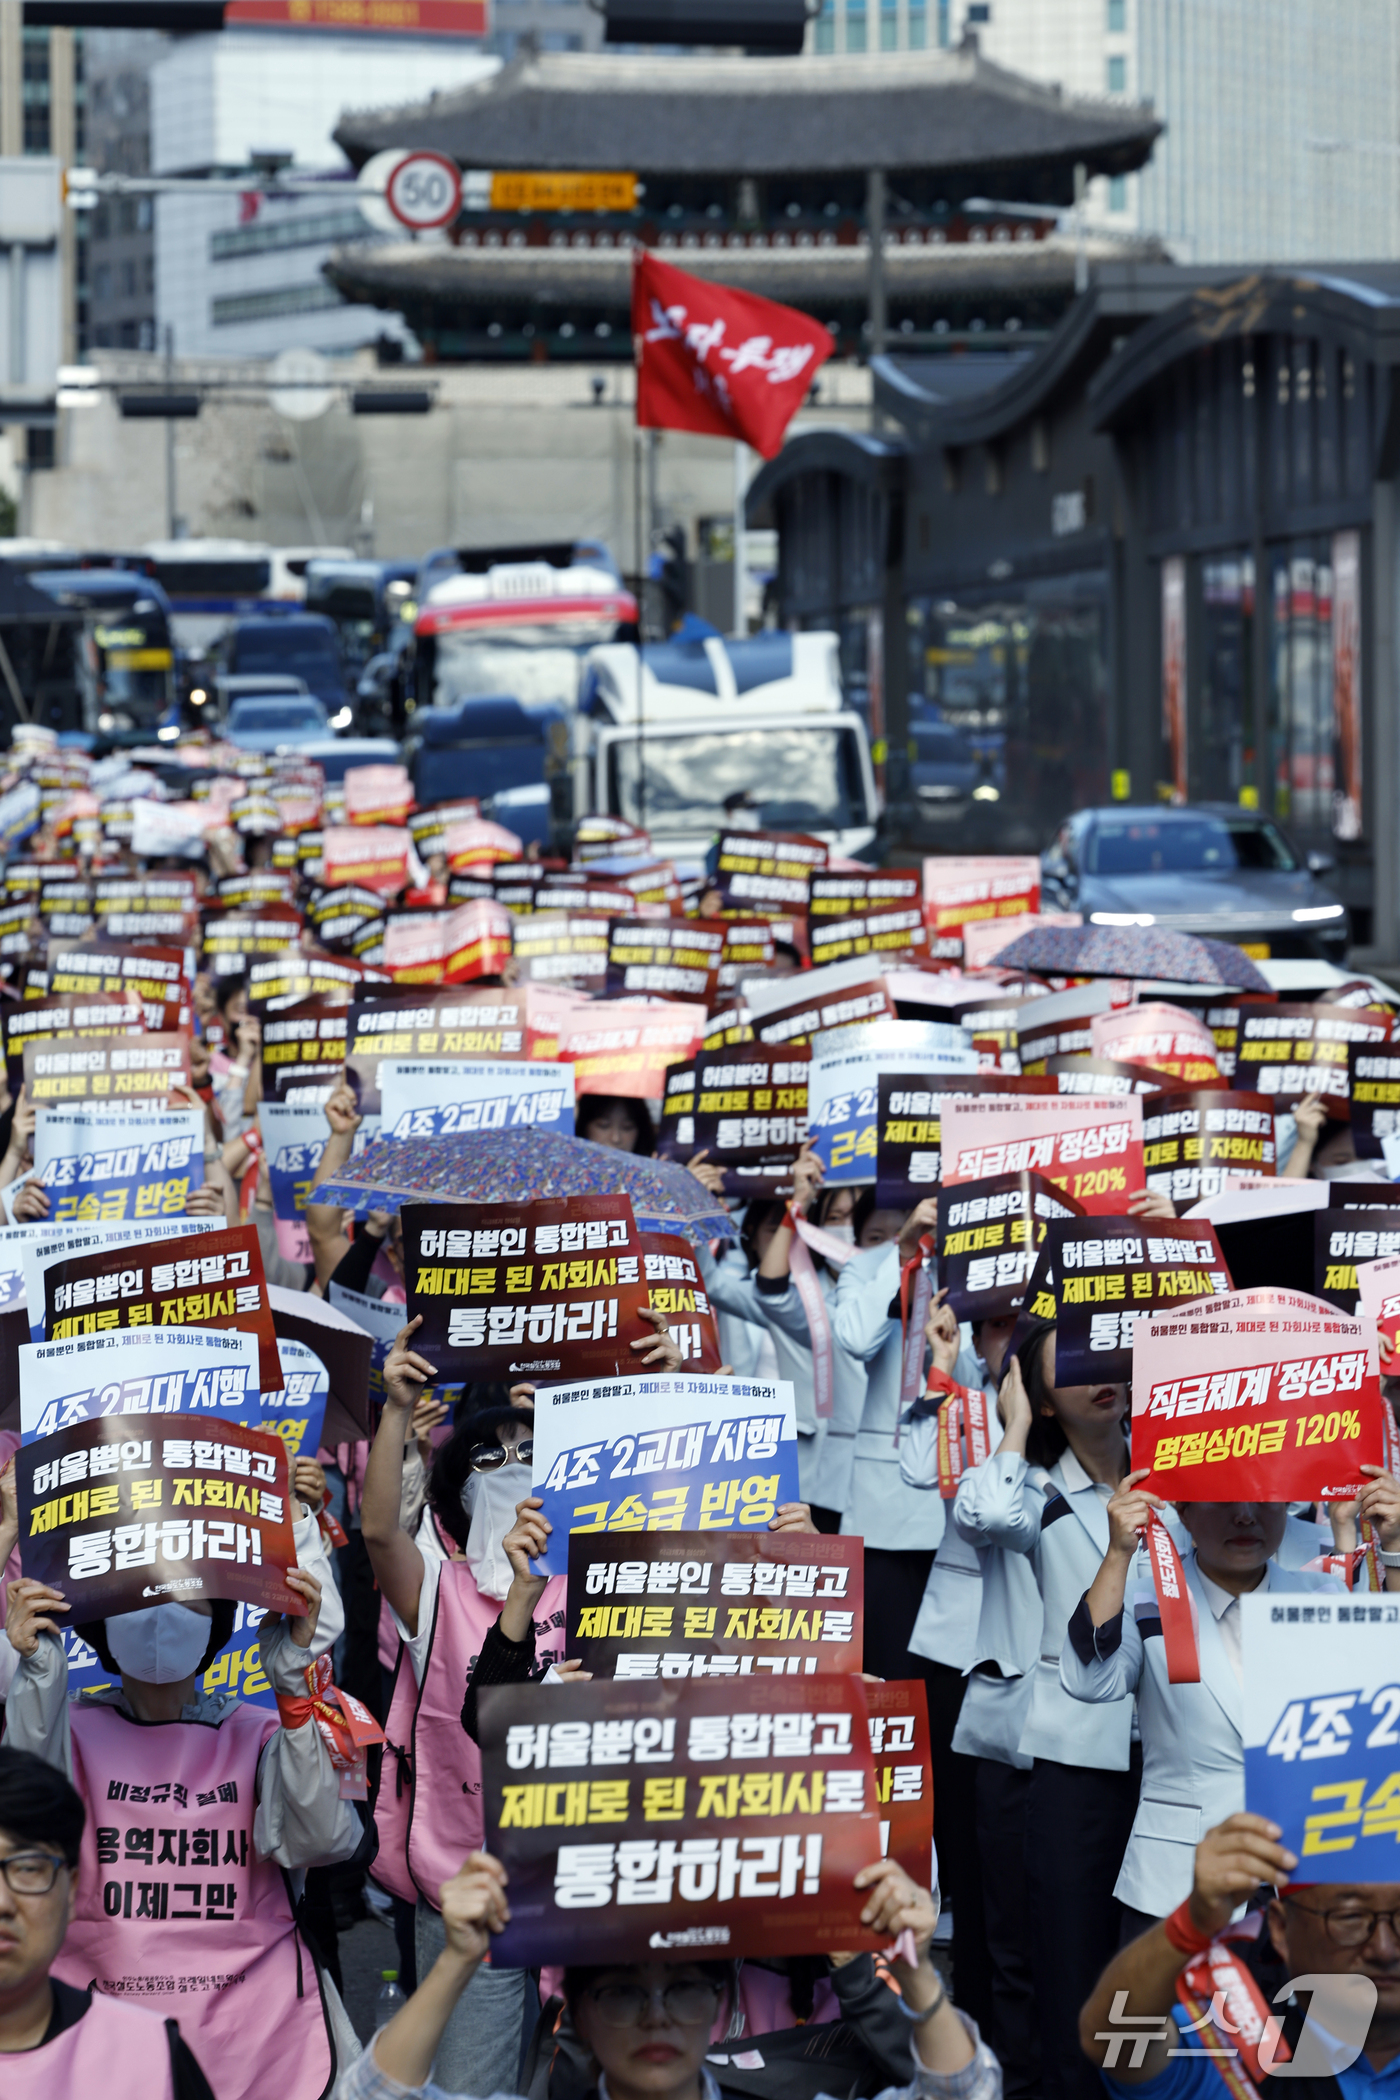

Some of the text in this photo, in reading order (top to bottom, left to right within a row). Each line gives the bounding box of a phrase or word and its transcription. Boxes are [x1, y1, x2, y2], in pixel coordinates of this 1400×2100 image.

[403, 172, 448, 210] 50
[392, 1090, 566, 1141] 4조 2교대 시행
[41, 1135, 195, 1188] 4조 2교대 시행
[956, 1137, 1056, 1181] 직급체계
[1058, 1121, 1131, 1164] 정상화
[54, 1176, 191, 1223] 근속급 반영
[1073, 1166, 1127, 1199] 120%
[418, 1219, 631, 1259] 허울뿐인 통합말고
[1061, 1236, 1217, 1269] 허울뿐인 통합말고
[53, 1269, 144, 1314] 허울뿐인
[150, 1250, 250, 1294] 통합말고
[413, 1255, 641, 1297] 제대로 된 자회사로
[1061, 1269, 1230, 1304] 제대로 된 자회사로
[128, 1303, 154, 1327] 된
[160, 1284, 262, 1327] 자회사로
[446, 1297, 620, 1348] 통합하라!
[35, 1366, 251, 1437] 4조 2교대 시행
[1150, 1352, 1368, 1421] 직급체계 정상화
[544, 1416, 786, 1493] 4조 2교대 시행
[1153, 1409, 1361, 1472] 명절상여금 120%
[31, 1439, 278, 1496] 허울뿐인 통합말고
[28, 1478, 286, 1538] 제대로 된 자회사로
[569, 1473, 782, 1533] 근속급 반영
[67, 1518, 263, 1580] 통합하라!
[584, 1561, 851, 1599] 허울뿐인 통합말고
[575, 1605, 854, 1643] 제대로 된 자회사로
[505, 1713, 853, 1770] 허울뿐인 통합말고
[1267, 1693, 1357, 1762] 4조
[107, 1780, 240, 1809] 비정규직 철폐
[499, 1769, 866, 1829] 제대로 된 자회사로
[96, 1826, 249, 1868] 용역자회사
[554, 1833, 824, 1910] 통합하라!
[102, 1880, 238, 1921] 이제그만
